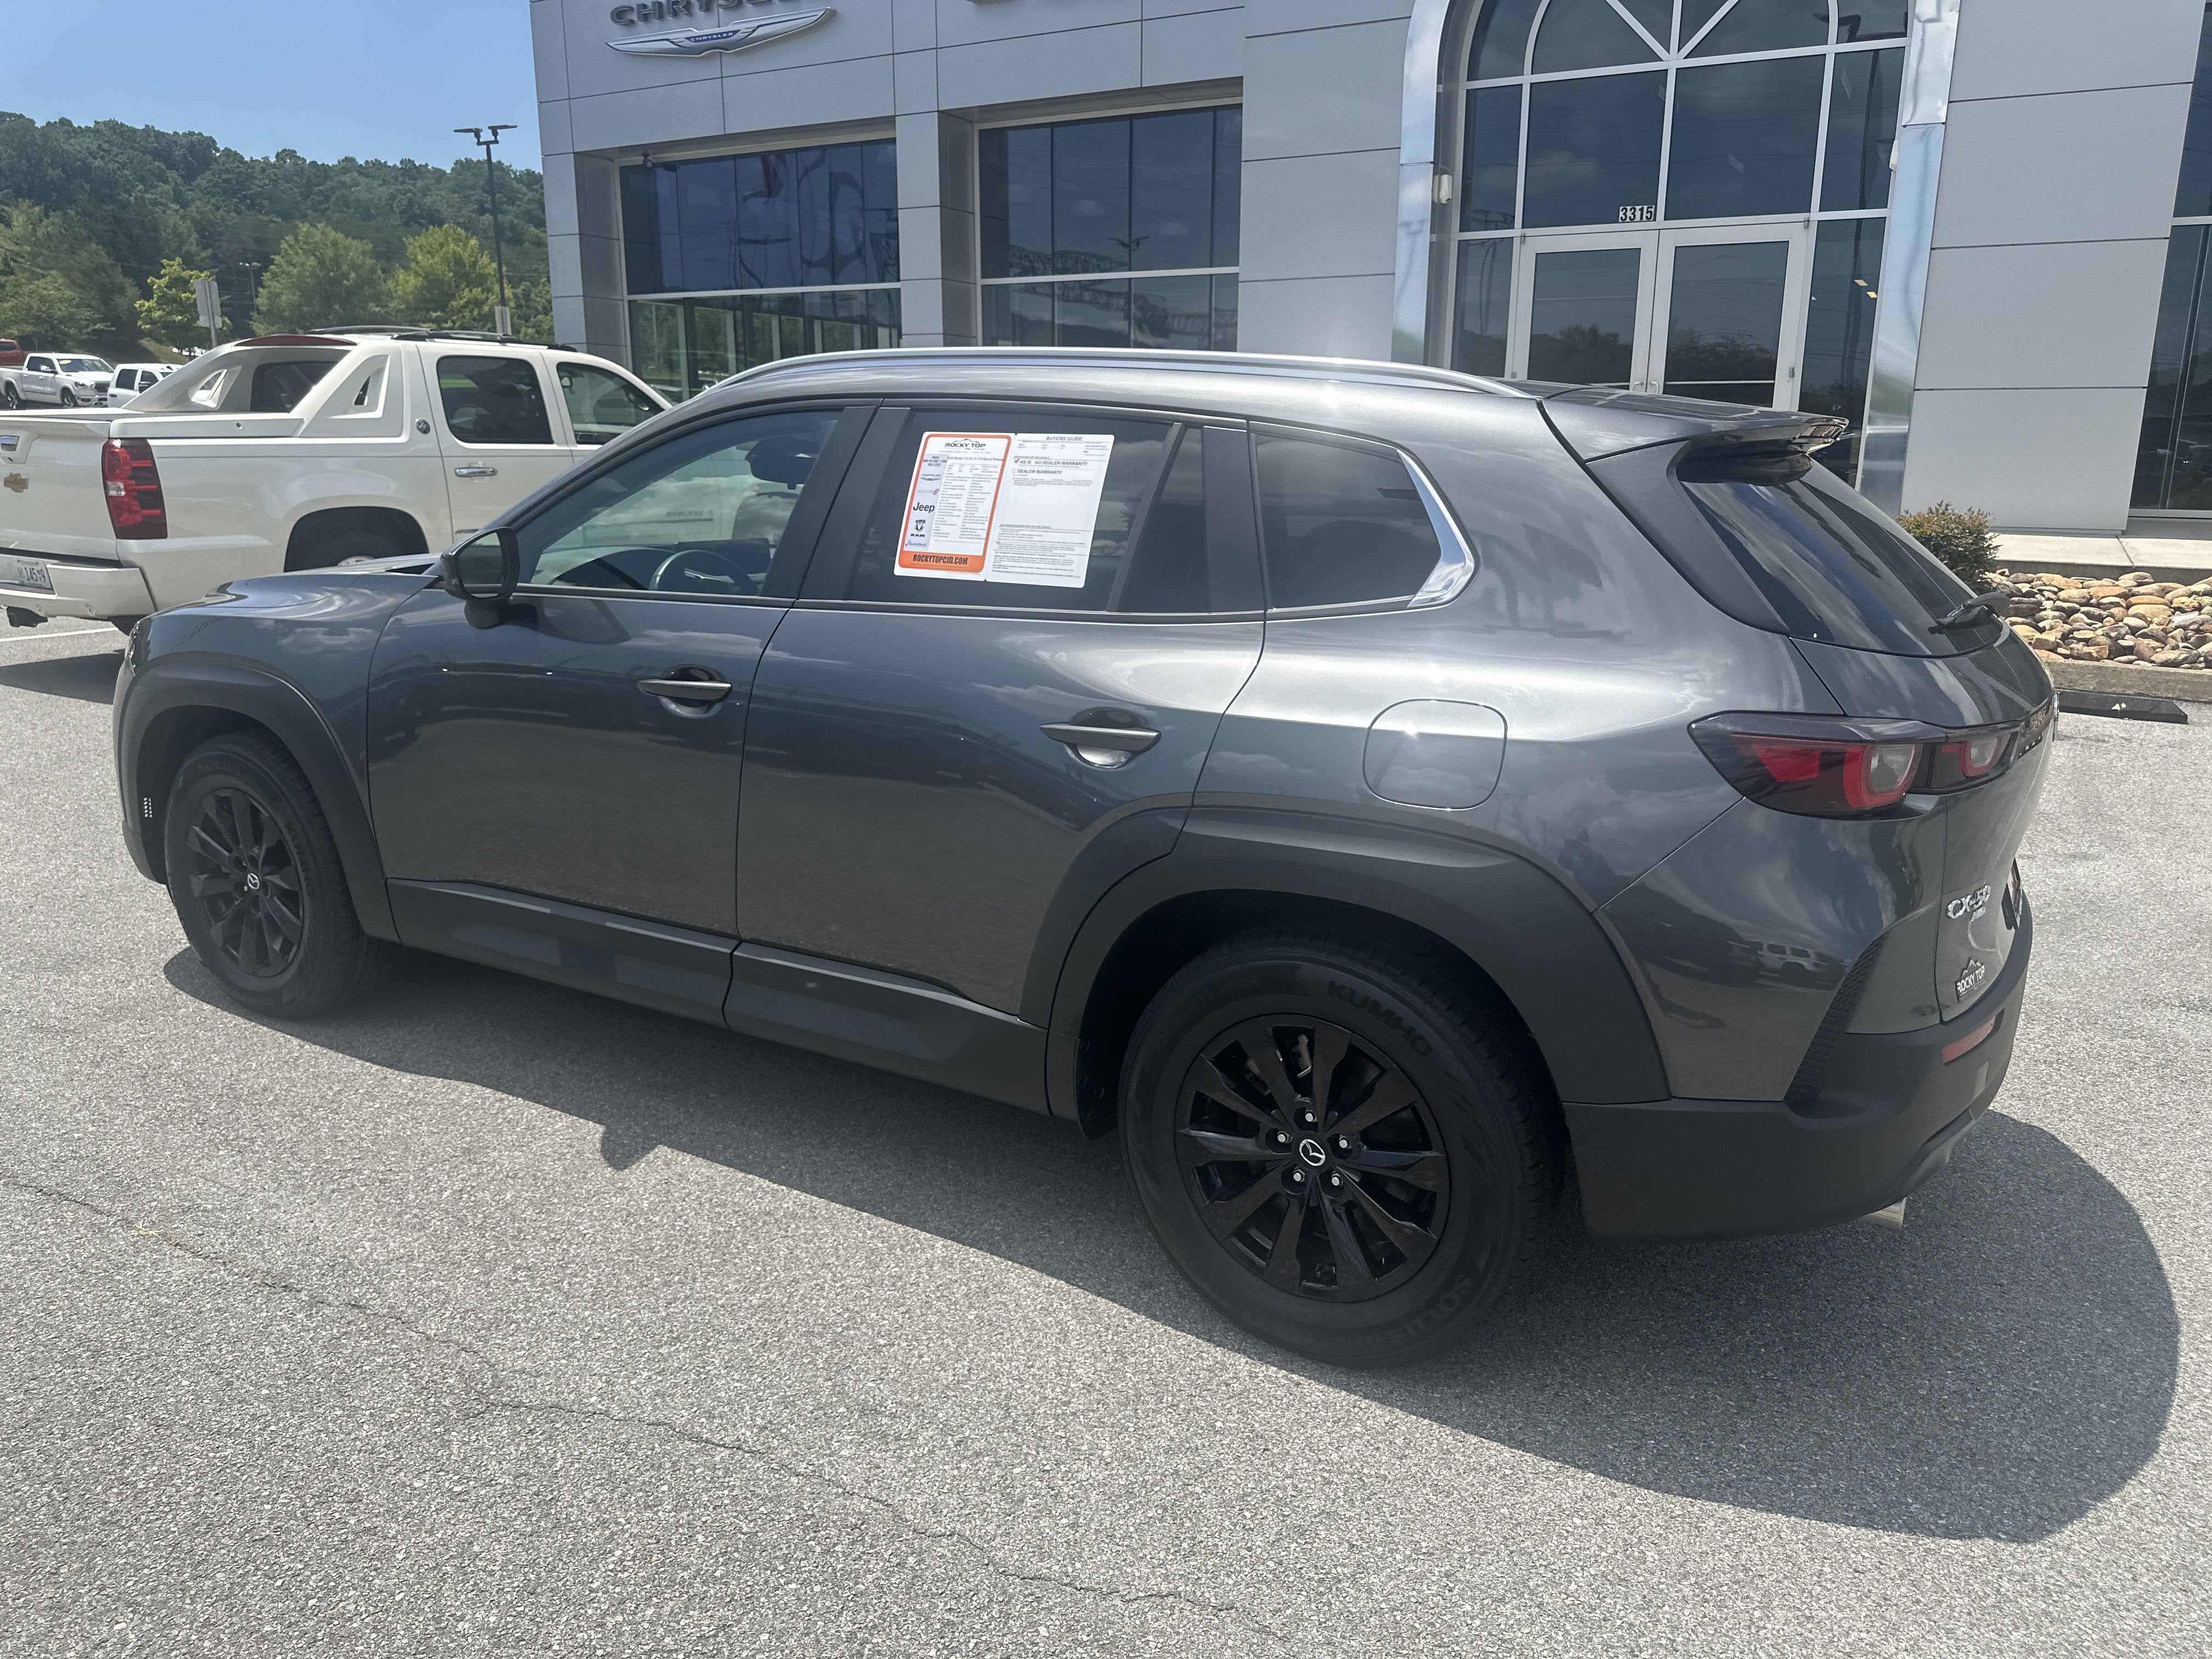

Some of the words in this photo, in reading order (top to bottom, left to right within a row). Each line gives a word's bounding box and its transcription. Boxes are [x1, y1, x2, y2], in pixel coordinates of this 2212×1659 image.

[690, 32, 734, 42] CHRYSLER
[1620, 205, 1654, 222] 3315
[913, 502, 935, 514] Jeep
[913, 554, 968, 565] ROCKYTOPCJD.COM
[1947, 885, 1990, 919] CX-50
[1957, 972, 1975, 993] ROCKY
[1975, 966, 1985, 981] TOP
[1328, 979, 1432, 1057] KUMHO
